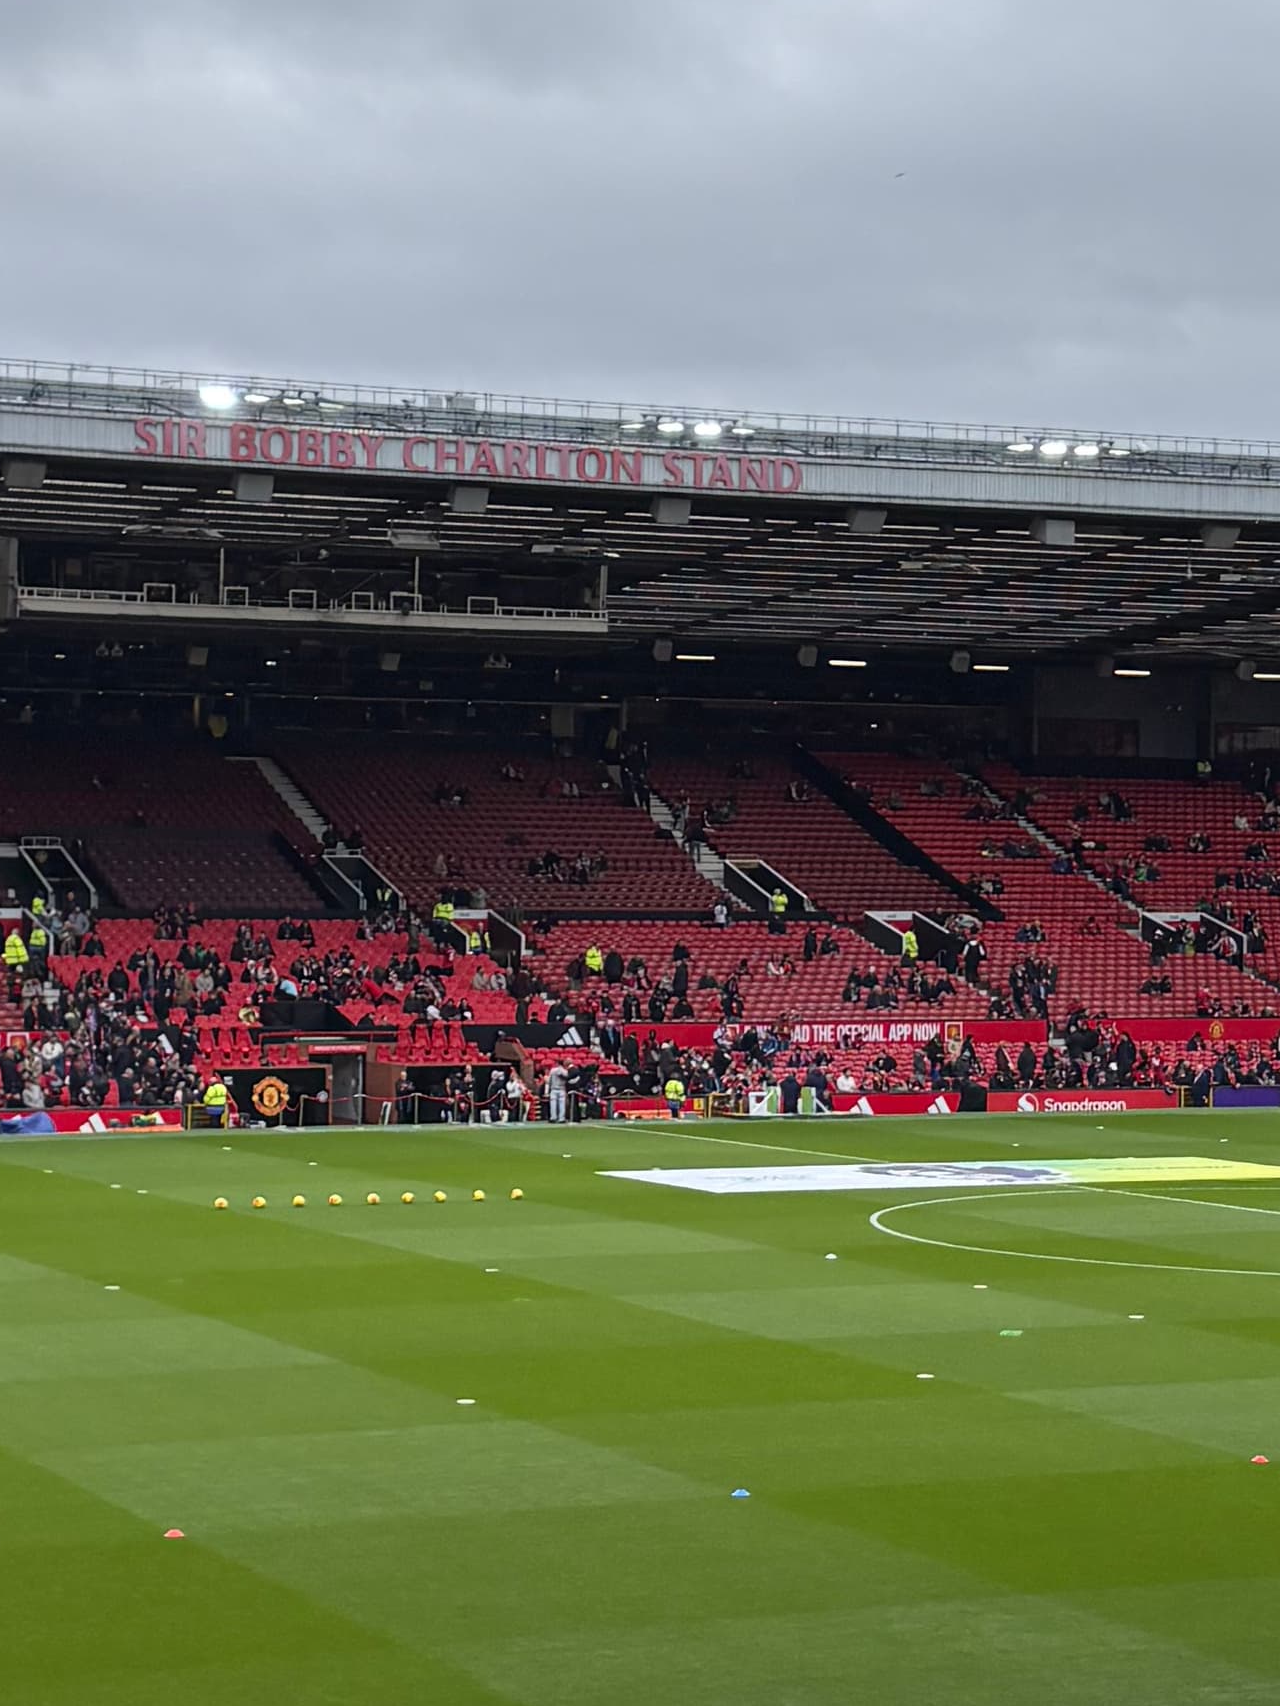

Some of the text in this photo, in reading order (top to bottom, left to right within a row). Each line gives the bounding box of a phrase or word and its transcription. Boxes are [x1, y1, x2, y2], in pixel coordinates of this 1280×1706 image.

[134, 417, 803, 494] SIR BOBBY CHARLTON STAND
[812, 1024, 835, 1043] THE
[888, 1022, 912, 1042] APP
[1044, 1097, 1127, 1112] Snapdragon
